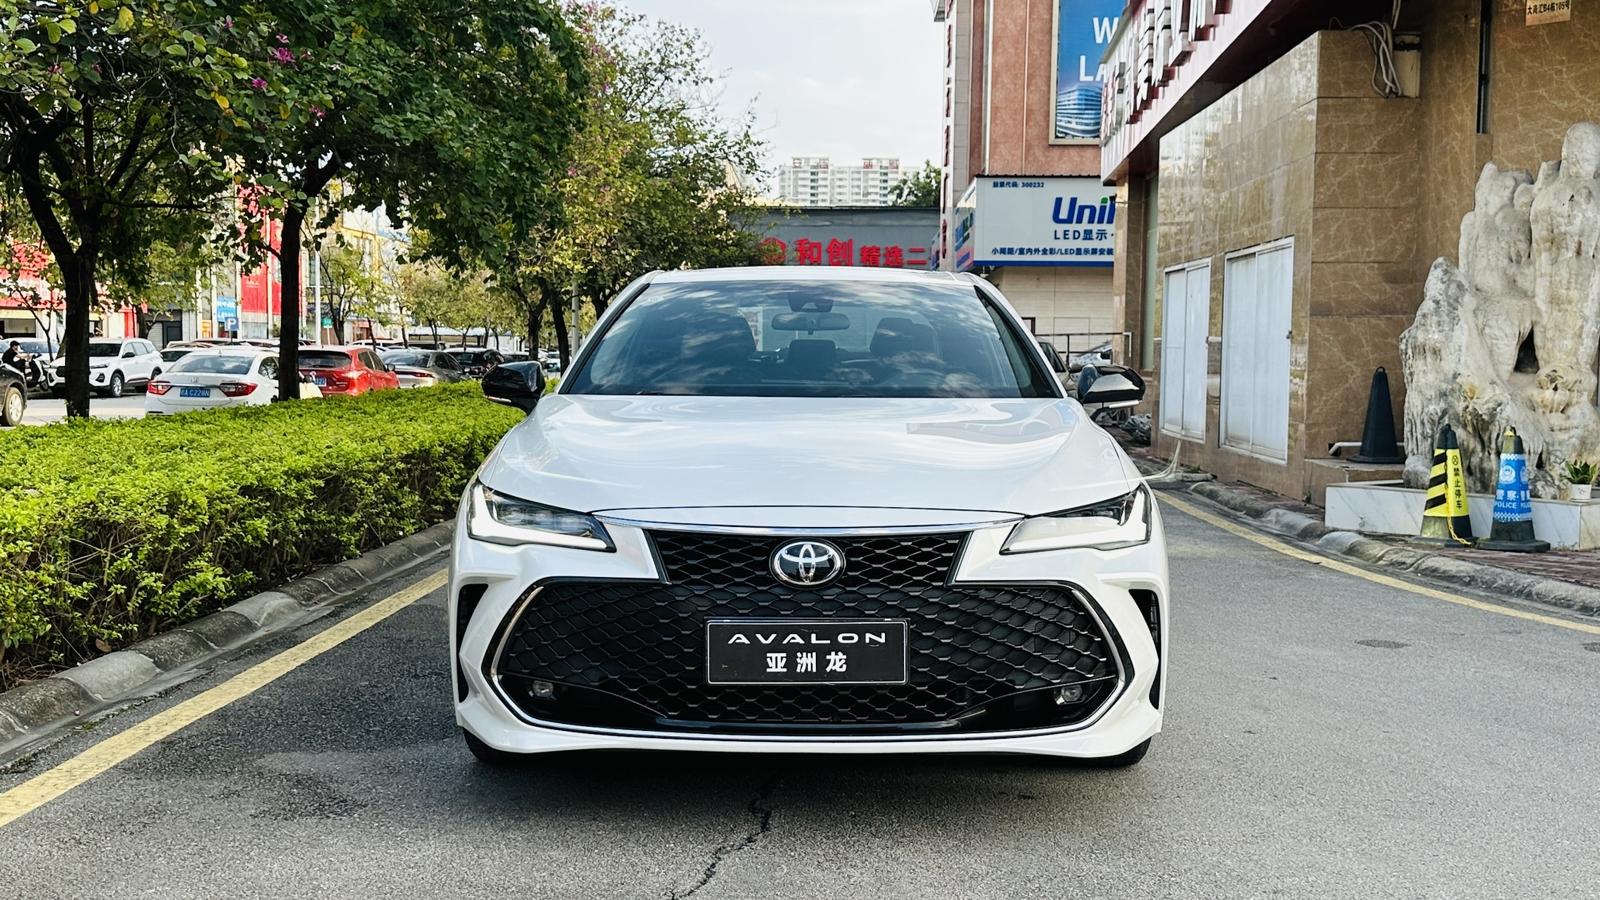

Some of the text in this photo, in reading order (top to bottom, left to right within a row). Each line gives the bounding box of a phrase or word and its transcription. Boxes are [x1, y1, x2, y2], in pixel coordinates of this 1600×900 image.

[227, 318, 237, 331] P
[727, 632, 886, 645] AVALON
[766, 651, 847, 673] 亚洲龙
